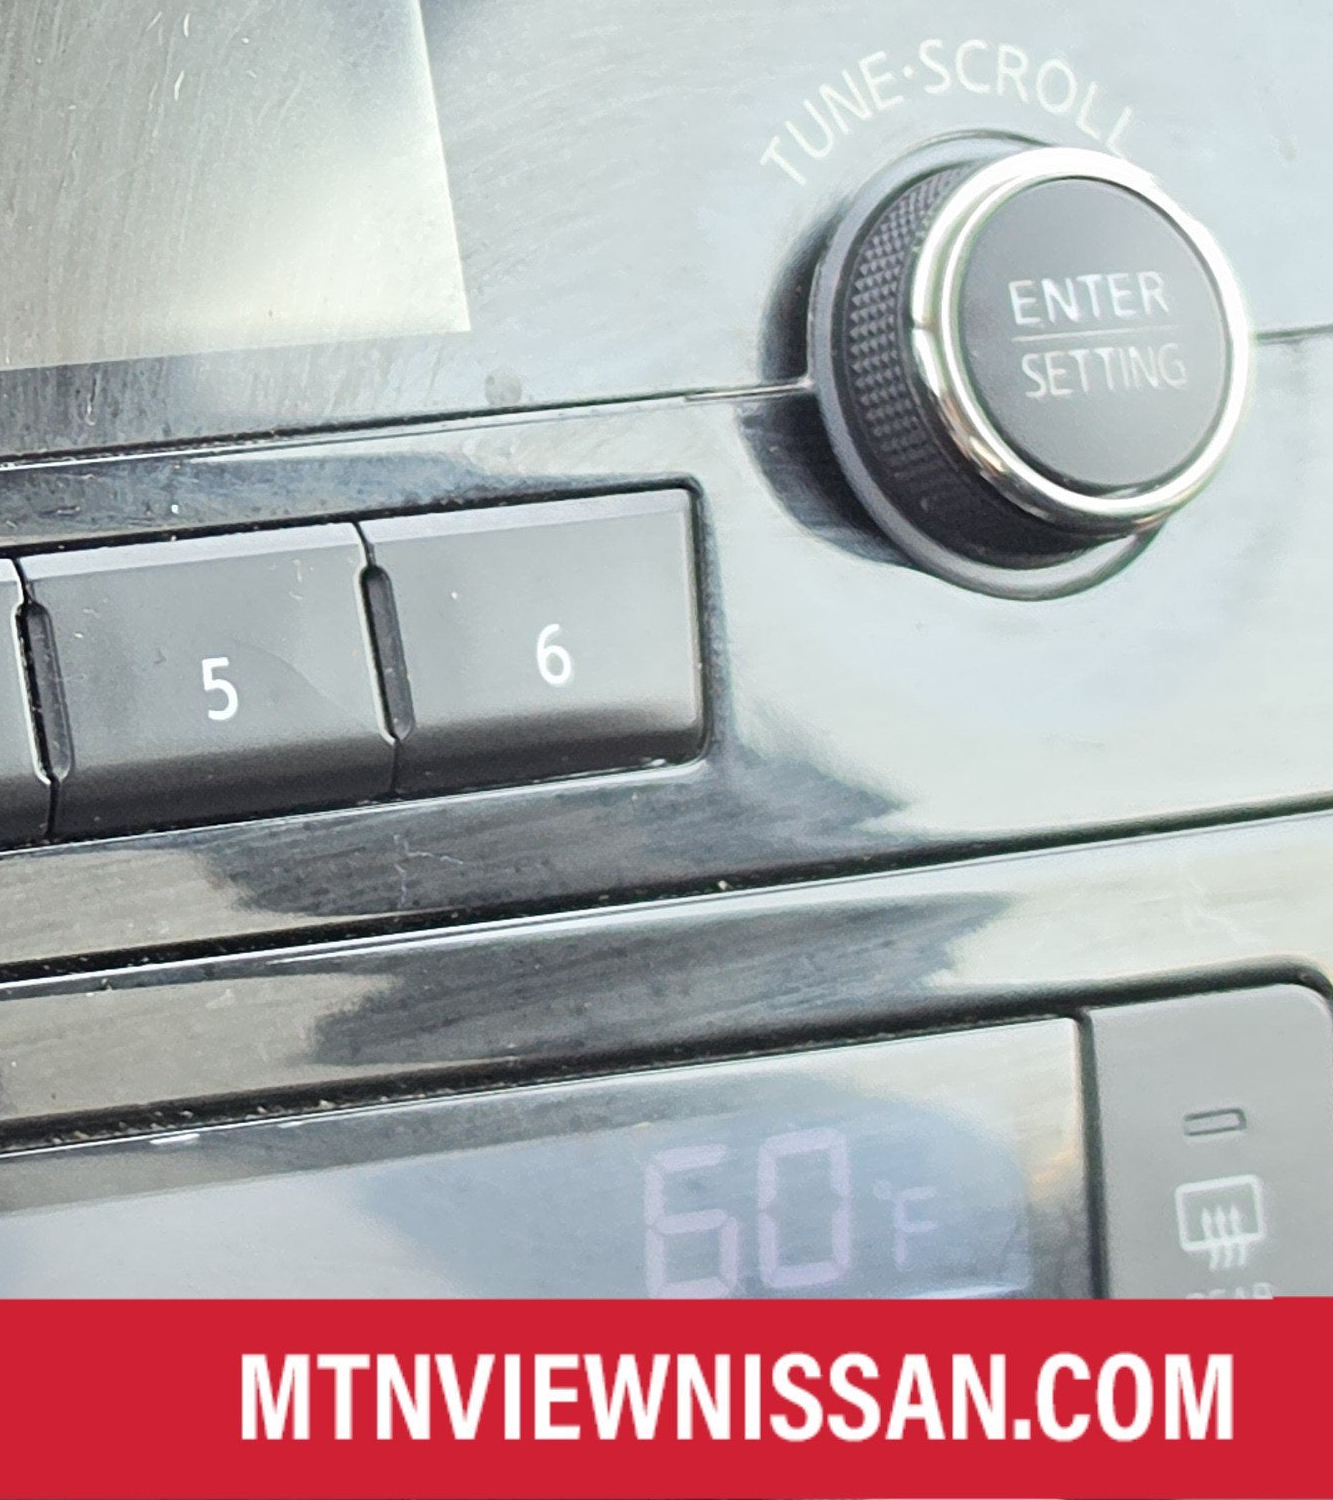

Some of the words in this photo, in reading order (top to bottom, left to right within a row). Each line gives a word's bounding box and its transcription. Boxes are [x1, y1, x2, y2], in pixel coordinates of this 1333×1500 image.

[1008, 271, 1170, 326] ENTER
[1021, 344, 1188, 398] SETTING
[536, 624, 574, 685] 6
[200, 657, 238, 720] 5
